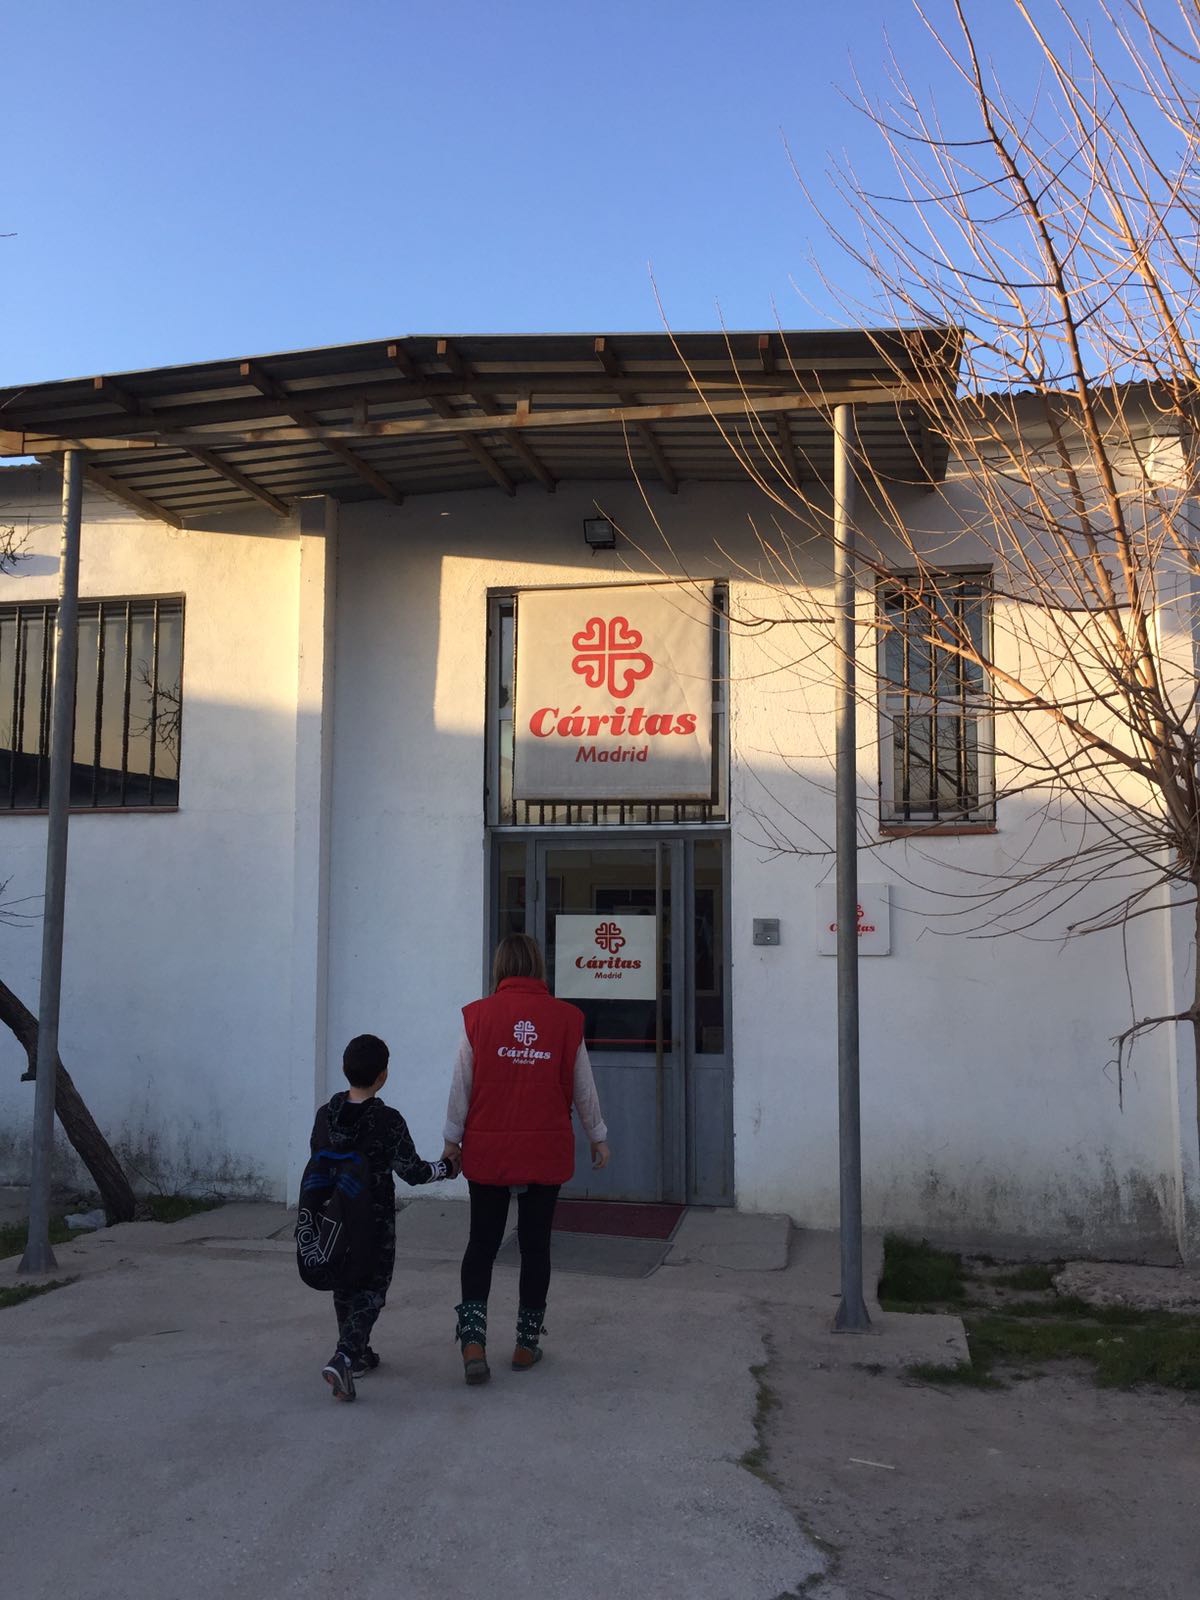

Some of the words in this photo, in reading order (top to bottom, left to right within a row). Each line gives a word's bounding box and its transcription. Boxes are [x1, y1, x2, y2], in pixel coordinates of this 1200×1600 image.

[529, 705, 697, 737] Cáritas
[575, 745, 649, 763] Madrid
[829, 923, 876, 932] Ctas
[575, 956, 642, 969] Cáritas
[497, 1046, 551, 1060] Cáritas
